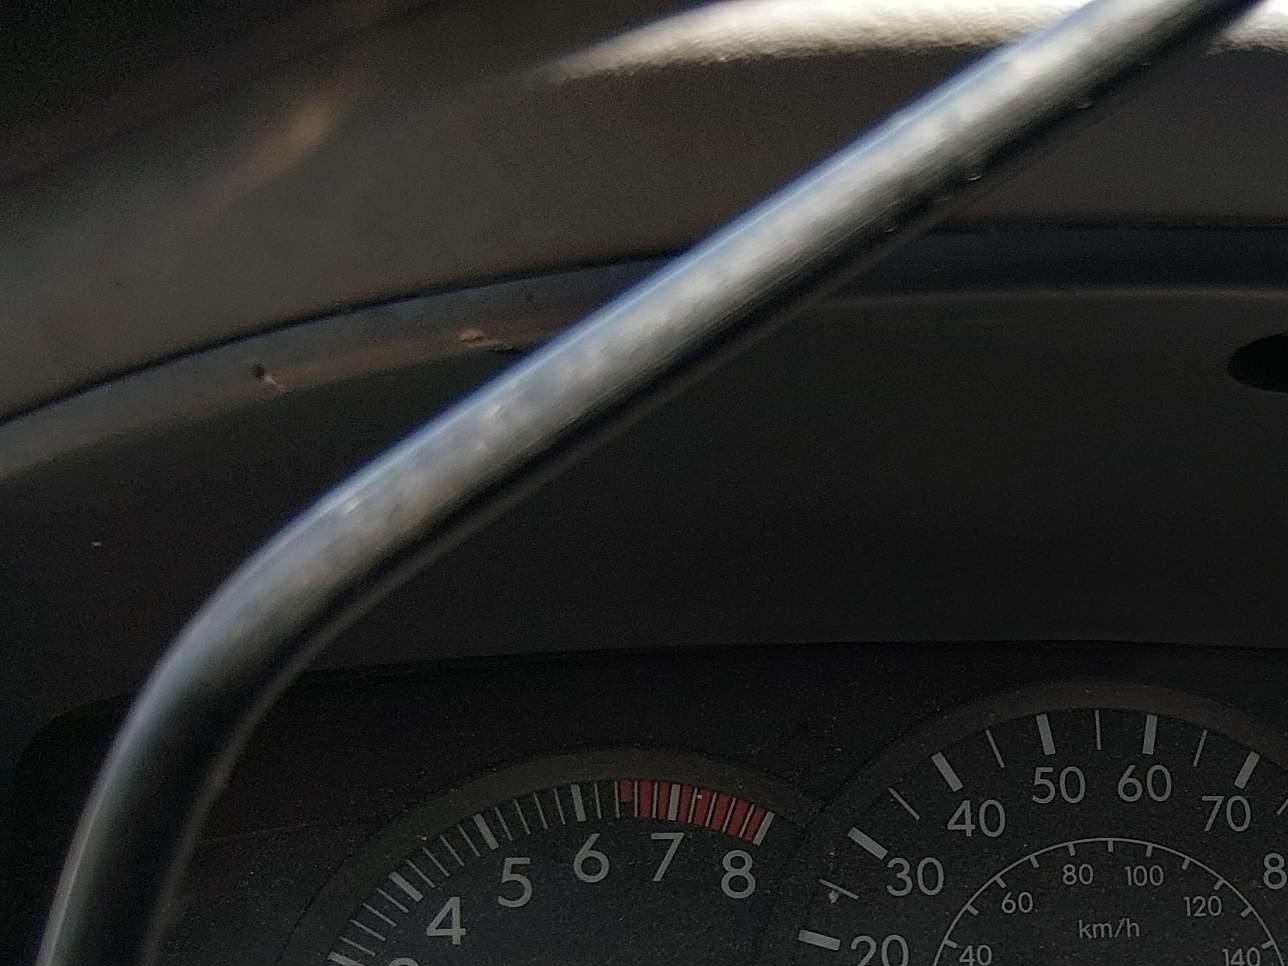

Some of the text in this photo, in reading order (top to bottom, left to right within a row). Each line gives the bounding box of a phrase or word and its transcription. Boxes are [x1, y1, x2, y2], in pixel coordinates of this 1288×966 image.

[1031, 767, 1086, 803] 50
[1117, 765, 1172, 802] 60
[946, 800, 1006, 837] 40
[1201, 796, 1251, 832] 70
[573, 833, 610, 882] 6
[650, 832, 685, 881] 7
[721, 850, 756, 898] 8
[1062, 864, 1094, 885] 80
[497, 857, 533, 908] 5
[886, 858, 944, 895] 30
[1125, 866, 1164, 887] 100
[426, 897, 467, 945] 4
[1001, 893, 1034, 914] 60
[1184, 896, 1222, 917] 120
[1079, 918, 1140, 939] km/h
[959, 945, 993, 966] 40
